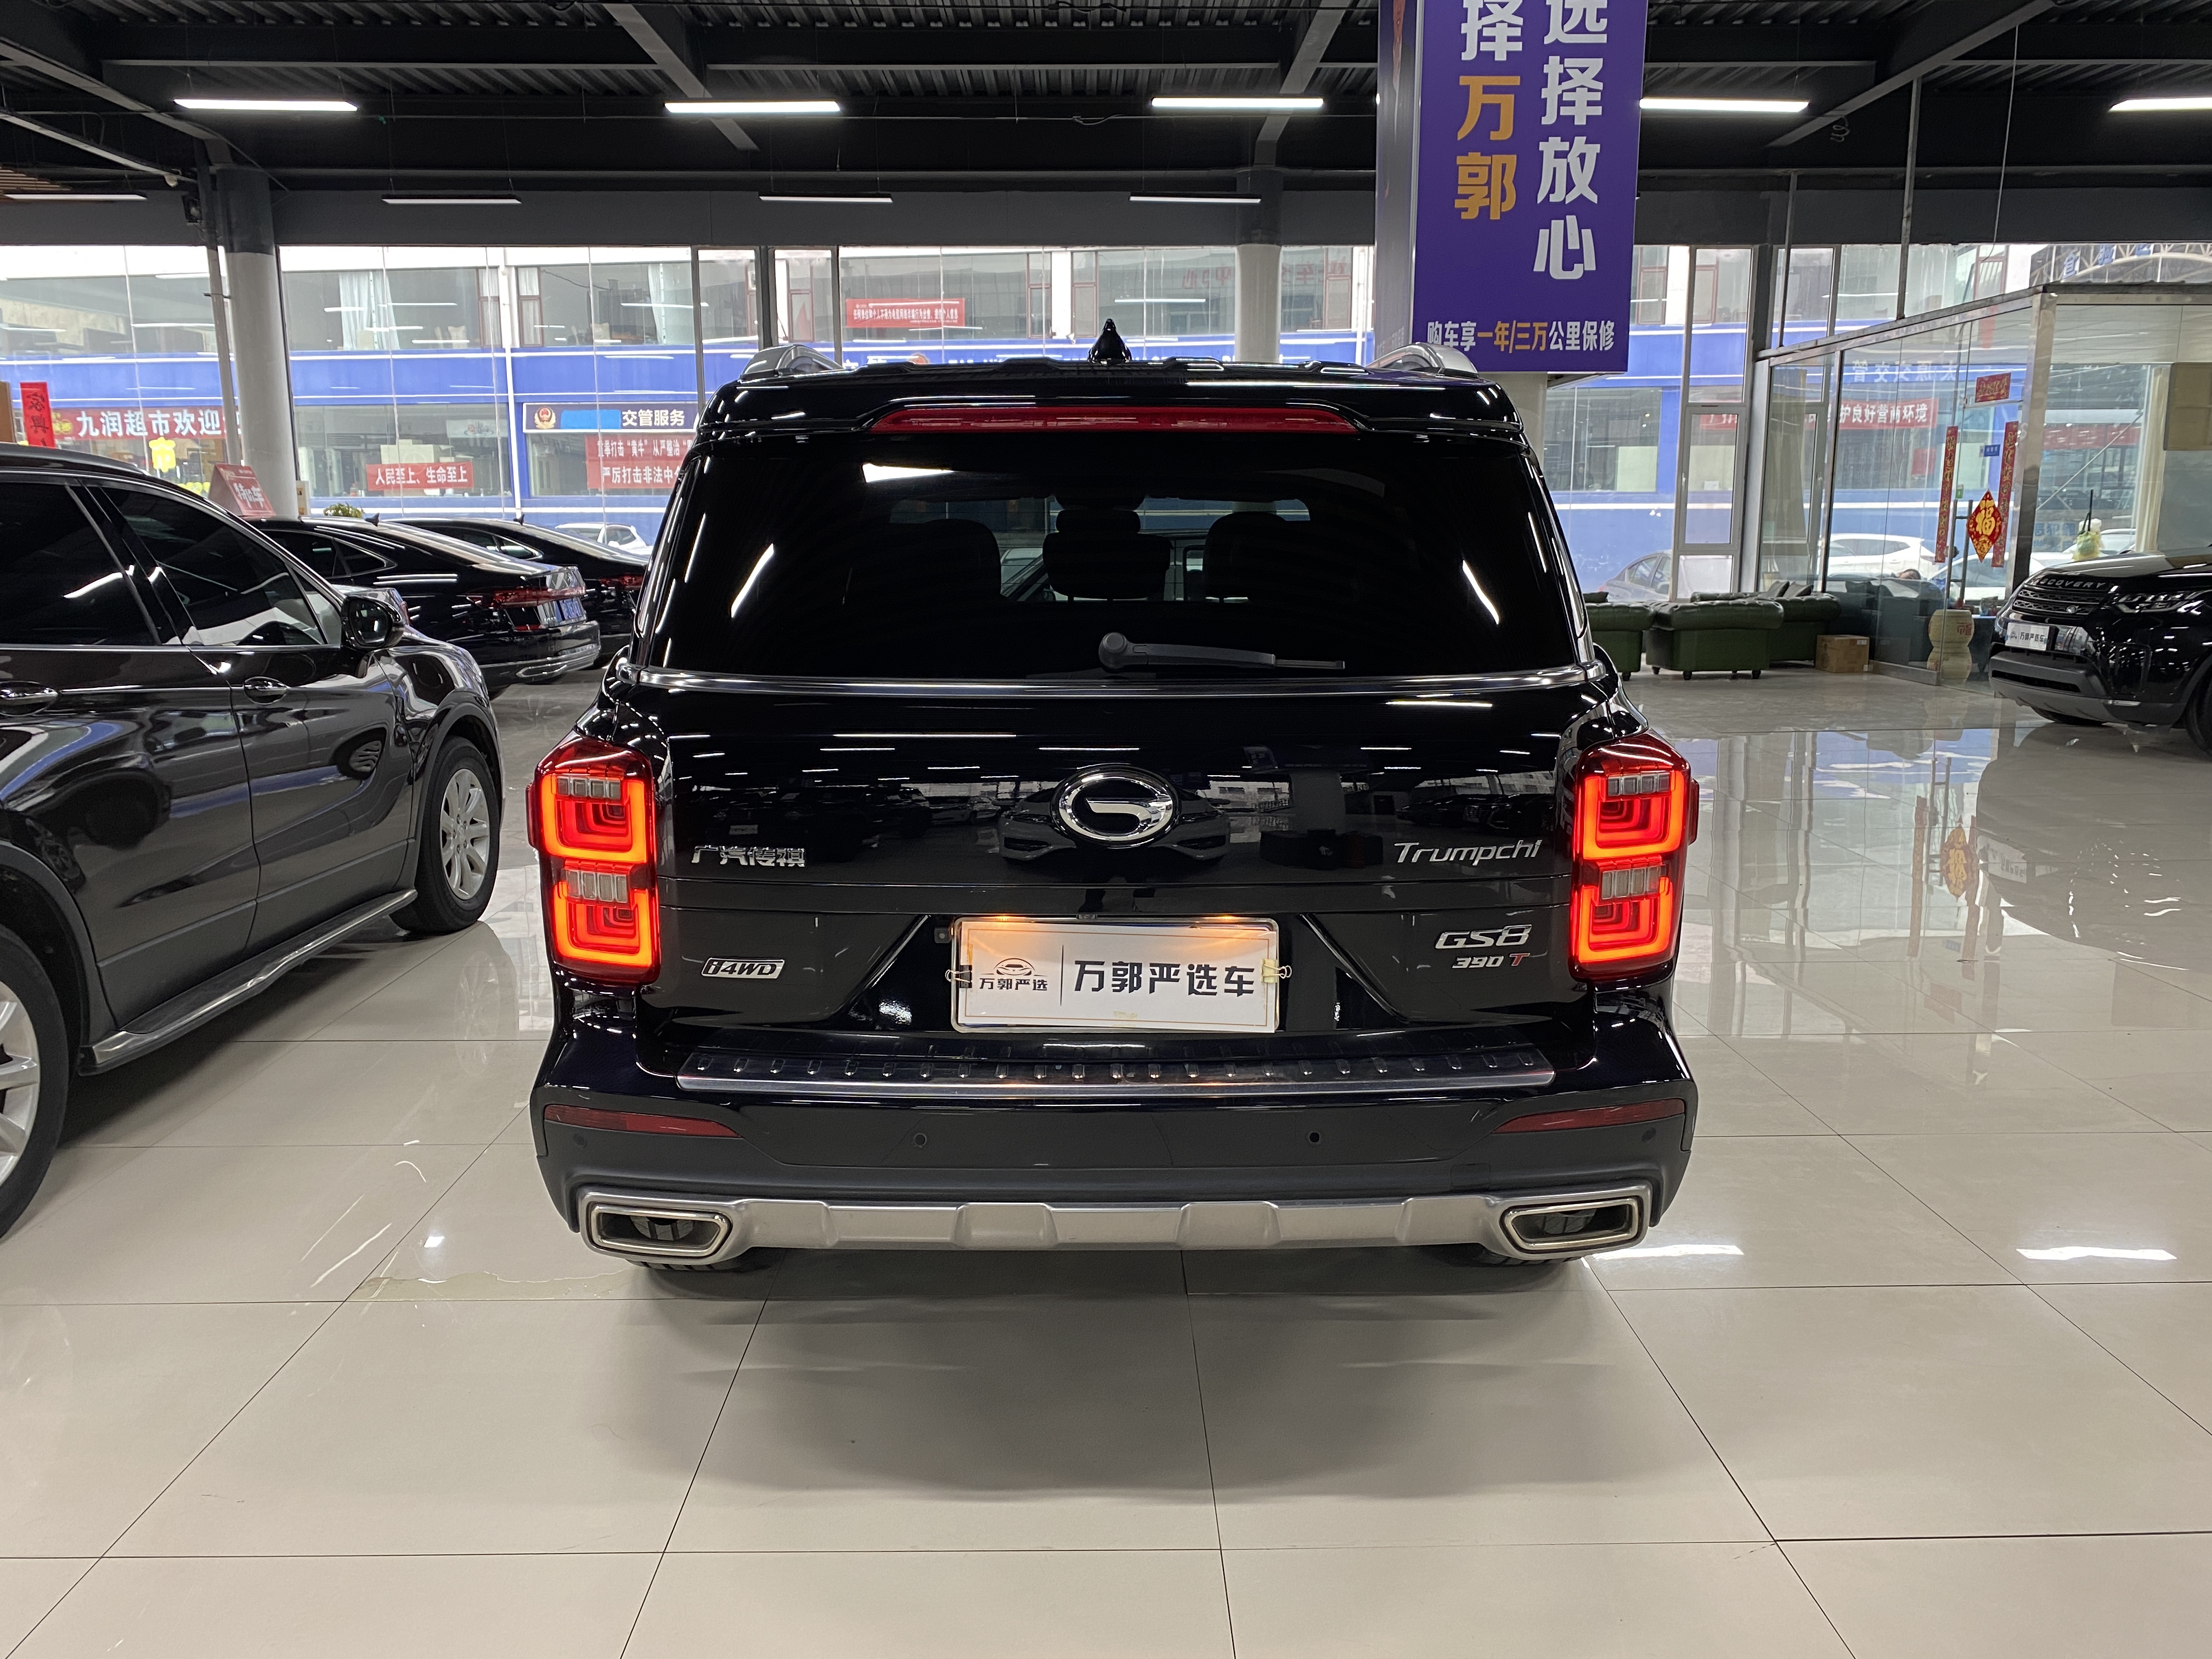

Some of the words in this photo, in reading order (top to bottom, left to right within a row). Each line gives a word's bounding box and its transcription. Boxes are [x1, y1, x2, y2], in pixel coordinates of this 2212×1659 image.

[1454, 0, 1523, 220] 择万郭
[1533, 0, 1608, 280] 选择放心
[1427, 320, 1616, 354] 购车享一年/三万公里保修
[77, 409, 240, 437] 九润超市欢迎
[622, 409, 685, 427] 交管服务
[375, 466, 468, 485] 人民至上、生命至上
[691, 845, 805, 867] 广汽传祺
[1394, 839, 1542, 866] Trumpchi
[1435, 924, 1532, 949] GS8
[979, 977, 1048, 991] 万郭严选
[1074, 960, 1255, 997] 万郭严选车
